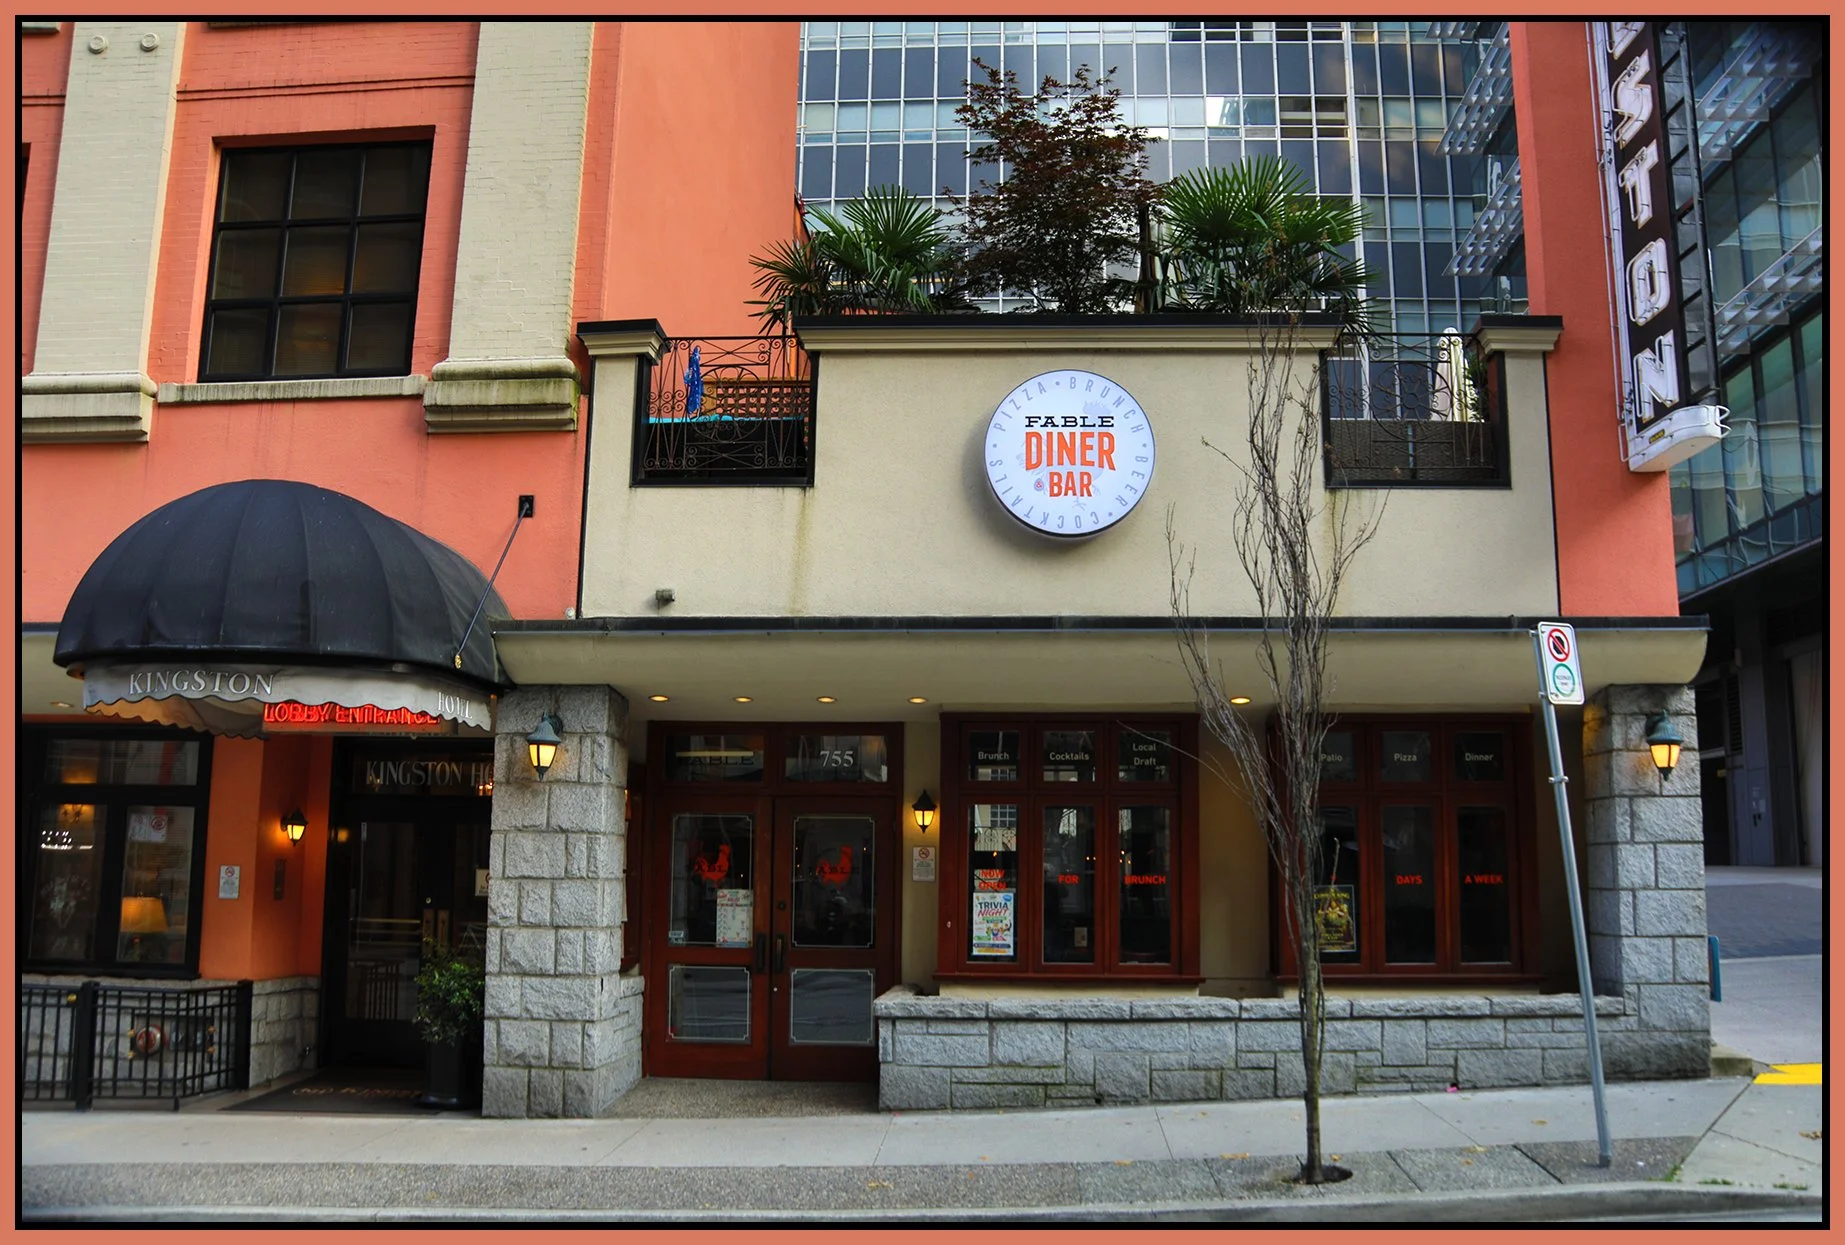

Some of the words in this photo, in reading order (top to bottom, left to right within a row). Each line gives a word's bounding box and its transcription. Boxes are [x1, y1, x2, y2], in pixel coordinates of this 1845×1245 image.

[993, 381, 1047, 432] PIZZA
[1069, 376, 1145, 433] BRUNCH
[1025, 416, 1115, 428] FABLE
[1025, 431, 1116, 471] DINER
[1049, 471, 1092, 497] BAR
[1115, 455, 1149, 507] BEER
[989, 459, 1100, 529] COCKTAILS
[129, 670, 275, 696] KINGSTON
[263, 702, 332, 723] LOBBY
[1132, 743, 1157, 752] Local
[820, 750, 854, 768] 755
[978, 751, 1010, 761] Brunch
[1049, 751, 1089, 761] Cocktails
[1320, 753, 1343, 762] Patio
[1394, 753, 1417, 762] Pizza
[1465, 752, 1494, 761] Dinner
[1133, 757, 1157, 766] Draft
[366, 760, 463, 786] KINGSTON
[980, 869, 1005, 878] NOW
[1058, 875, 1079, 884] FOR
[1124, 875, 1166, 884] BRUNCH
[1396, 876, 1423, 885] DAYS
[1464, 875, 1472, 884] A
[1474, 875, 1503, 884] WEEK
[978, 882, 1007, 891] OPEN
[978, 902, 1009, 910] TRIVIA
[978, 908, 1009, 918] NIGHT
